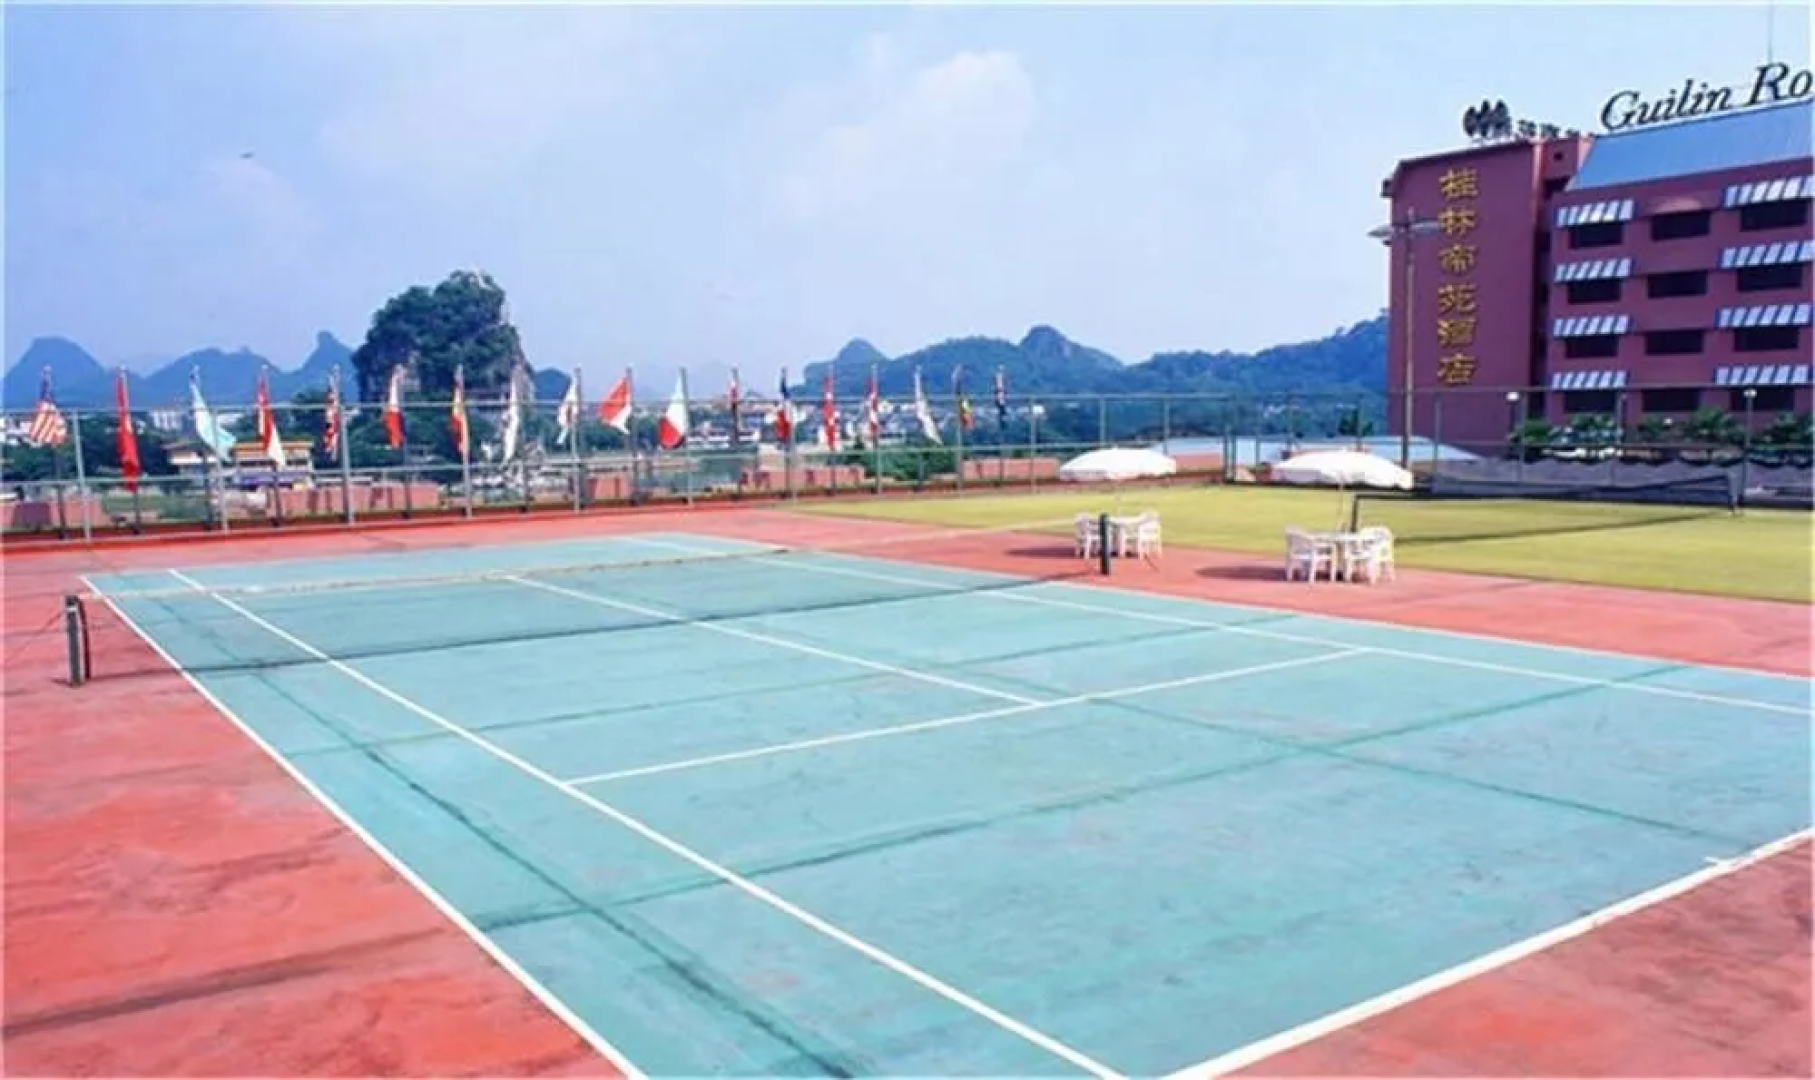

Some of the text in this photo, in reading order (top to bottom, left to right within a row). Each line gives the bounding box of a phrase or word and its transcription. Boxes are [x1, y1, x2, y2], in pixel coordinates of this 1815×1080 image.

[1600, 78, 1733, 131] Guilin
[1745, 61, 1814, 107] Ro
[1437, 167, 1479, 386] 桂林帝苑酒店
